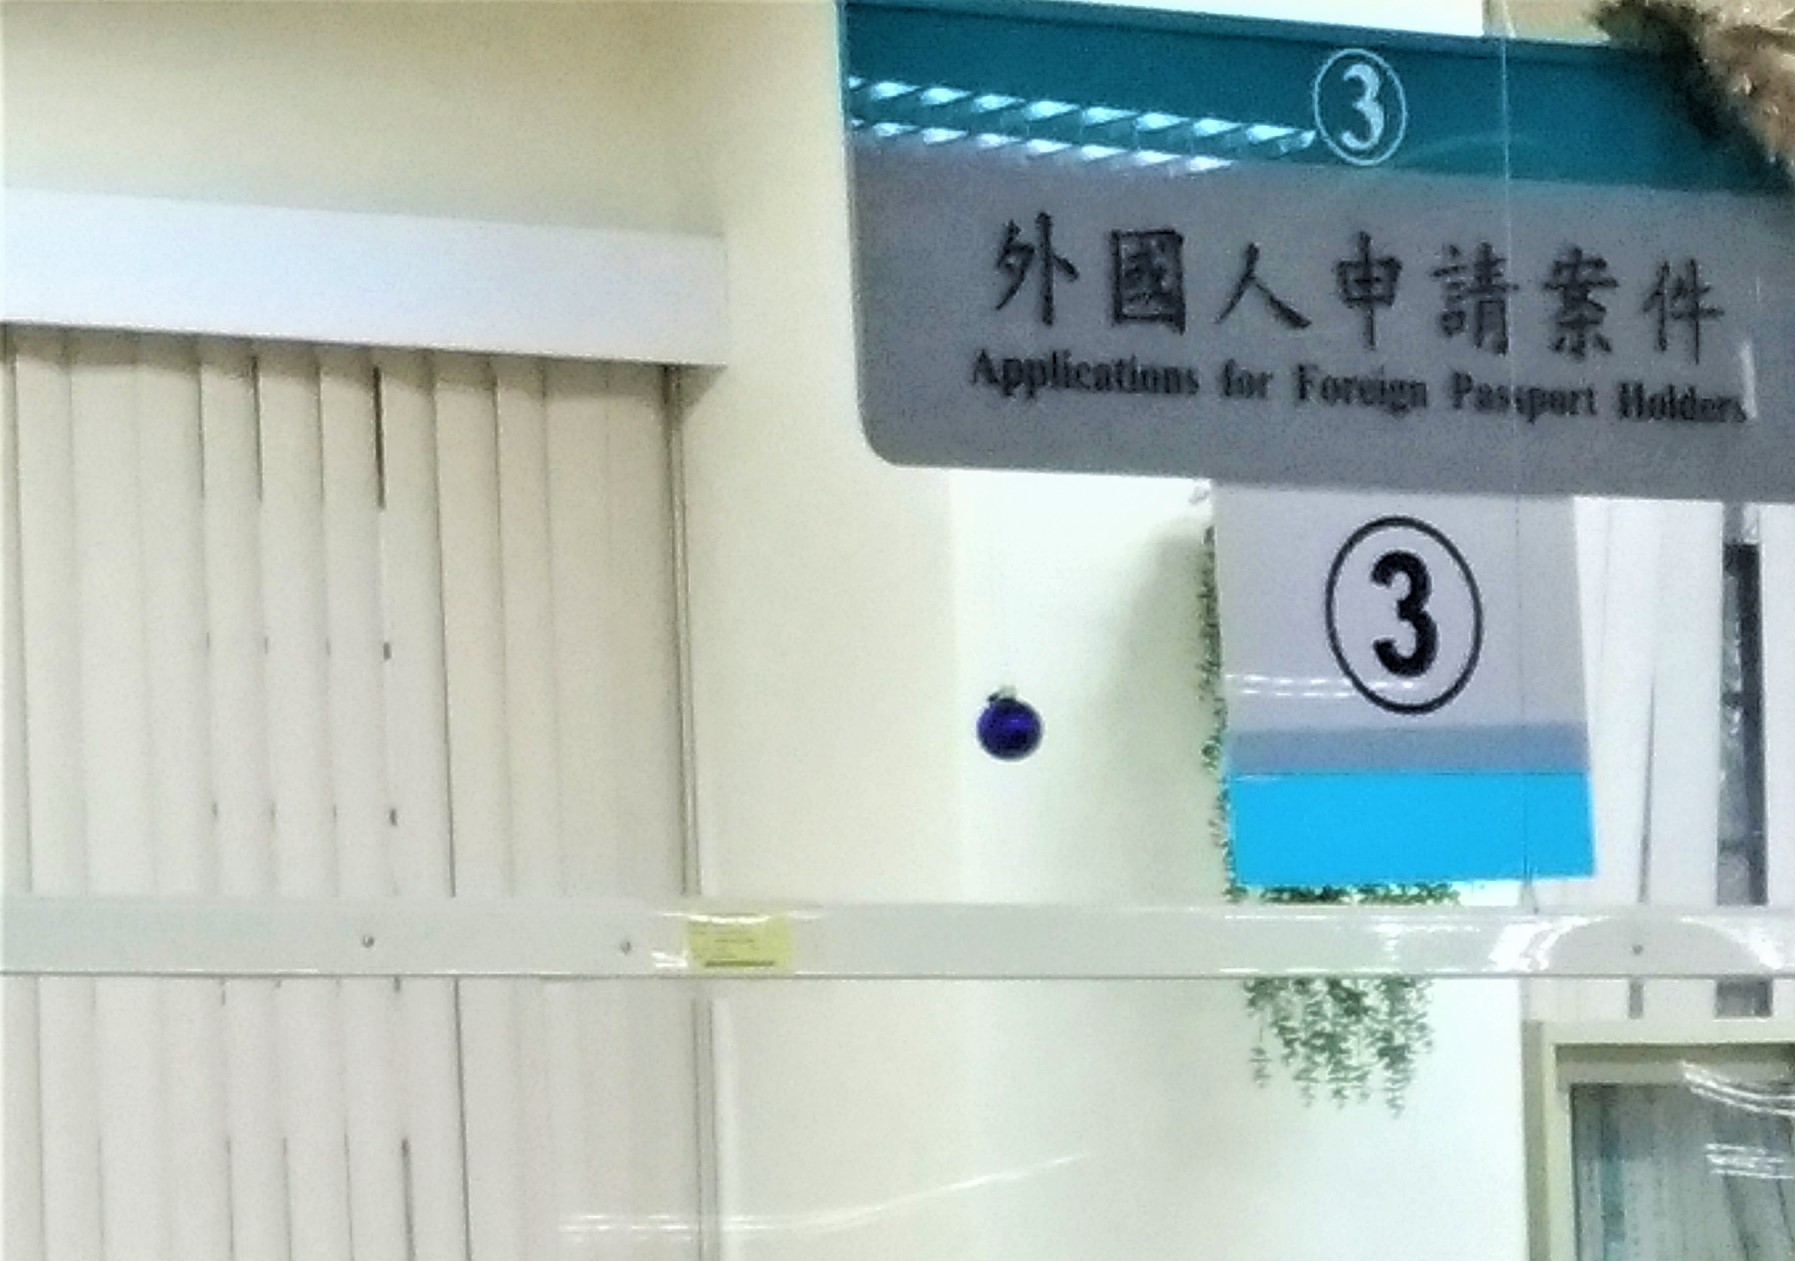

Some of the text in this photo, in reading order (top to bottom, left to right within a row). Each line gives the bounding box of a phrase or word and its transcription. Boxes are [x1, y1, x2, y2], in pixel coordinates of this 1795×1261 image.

[994, 211, 1725, 364] 外國人申請案件
[971, 349, 1748, 424] Applications for Foreign Passport Holders
